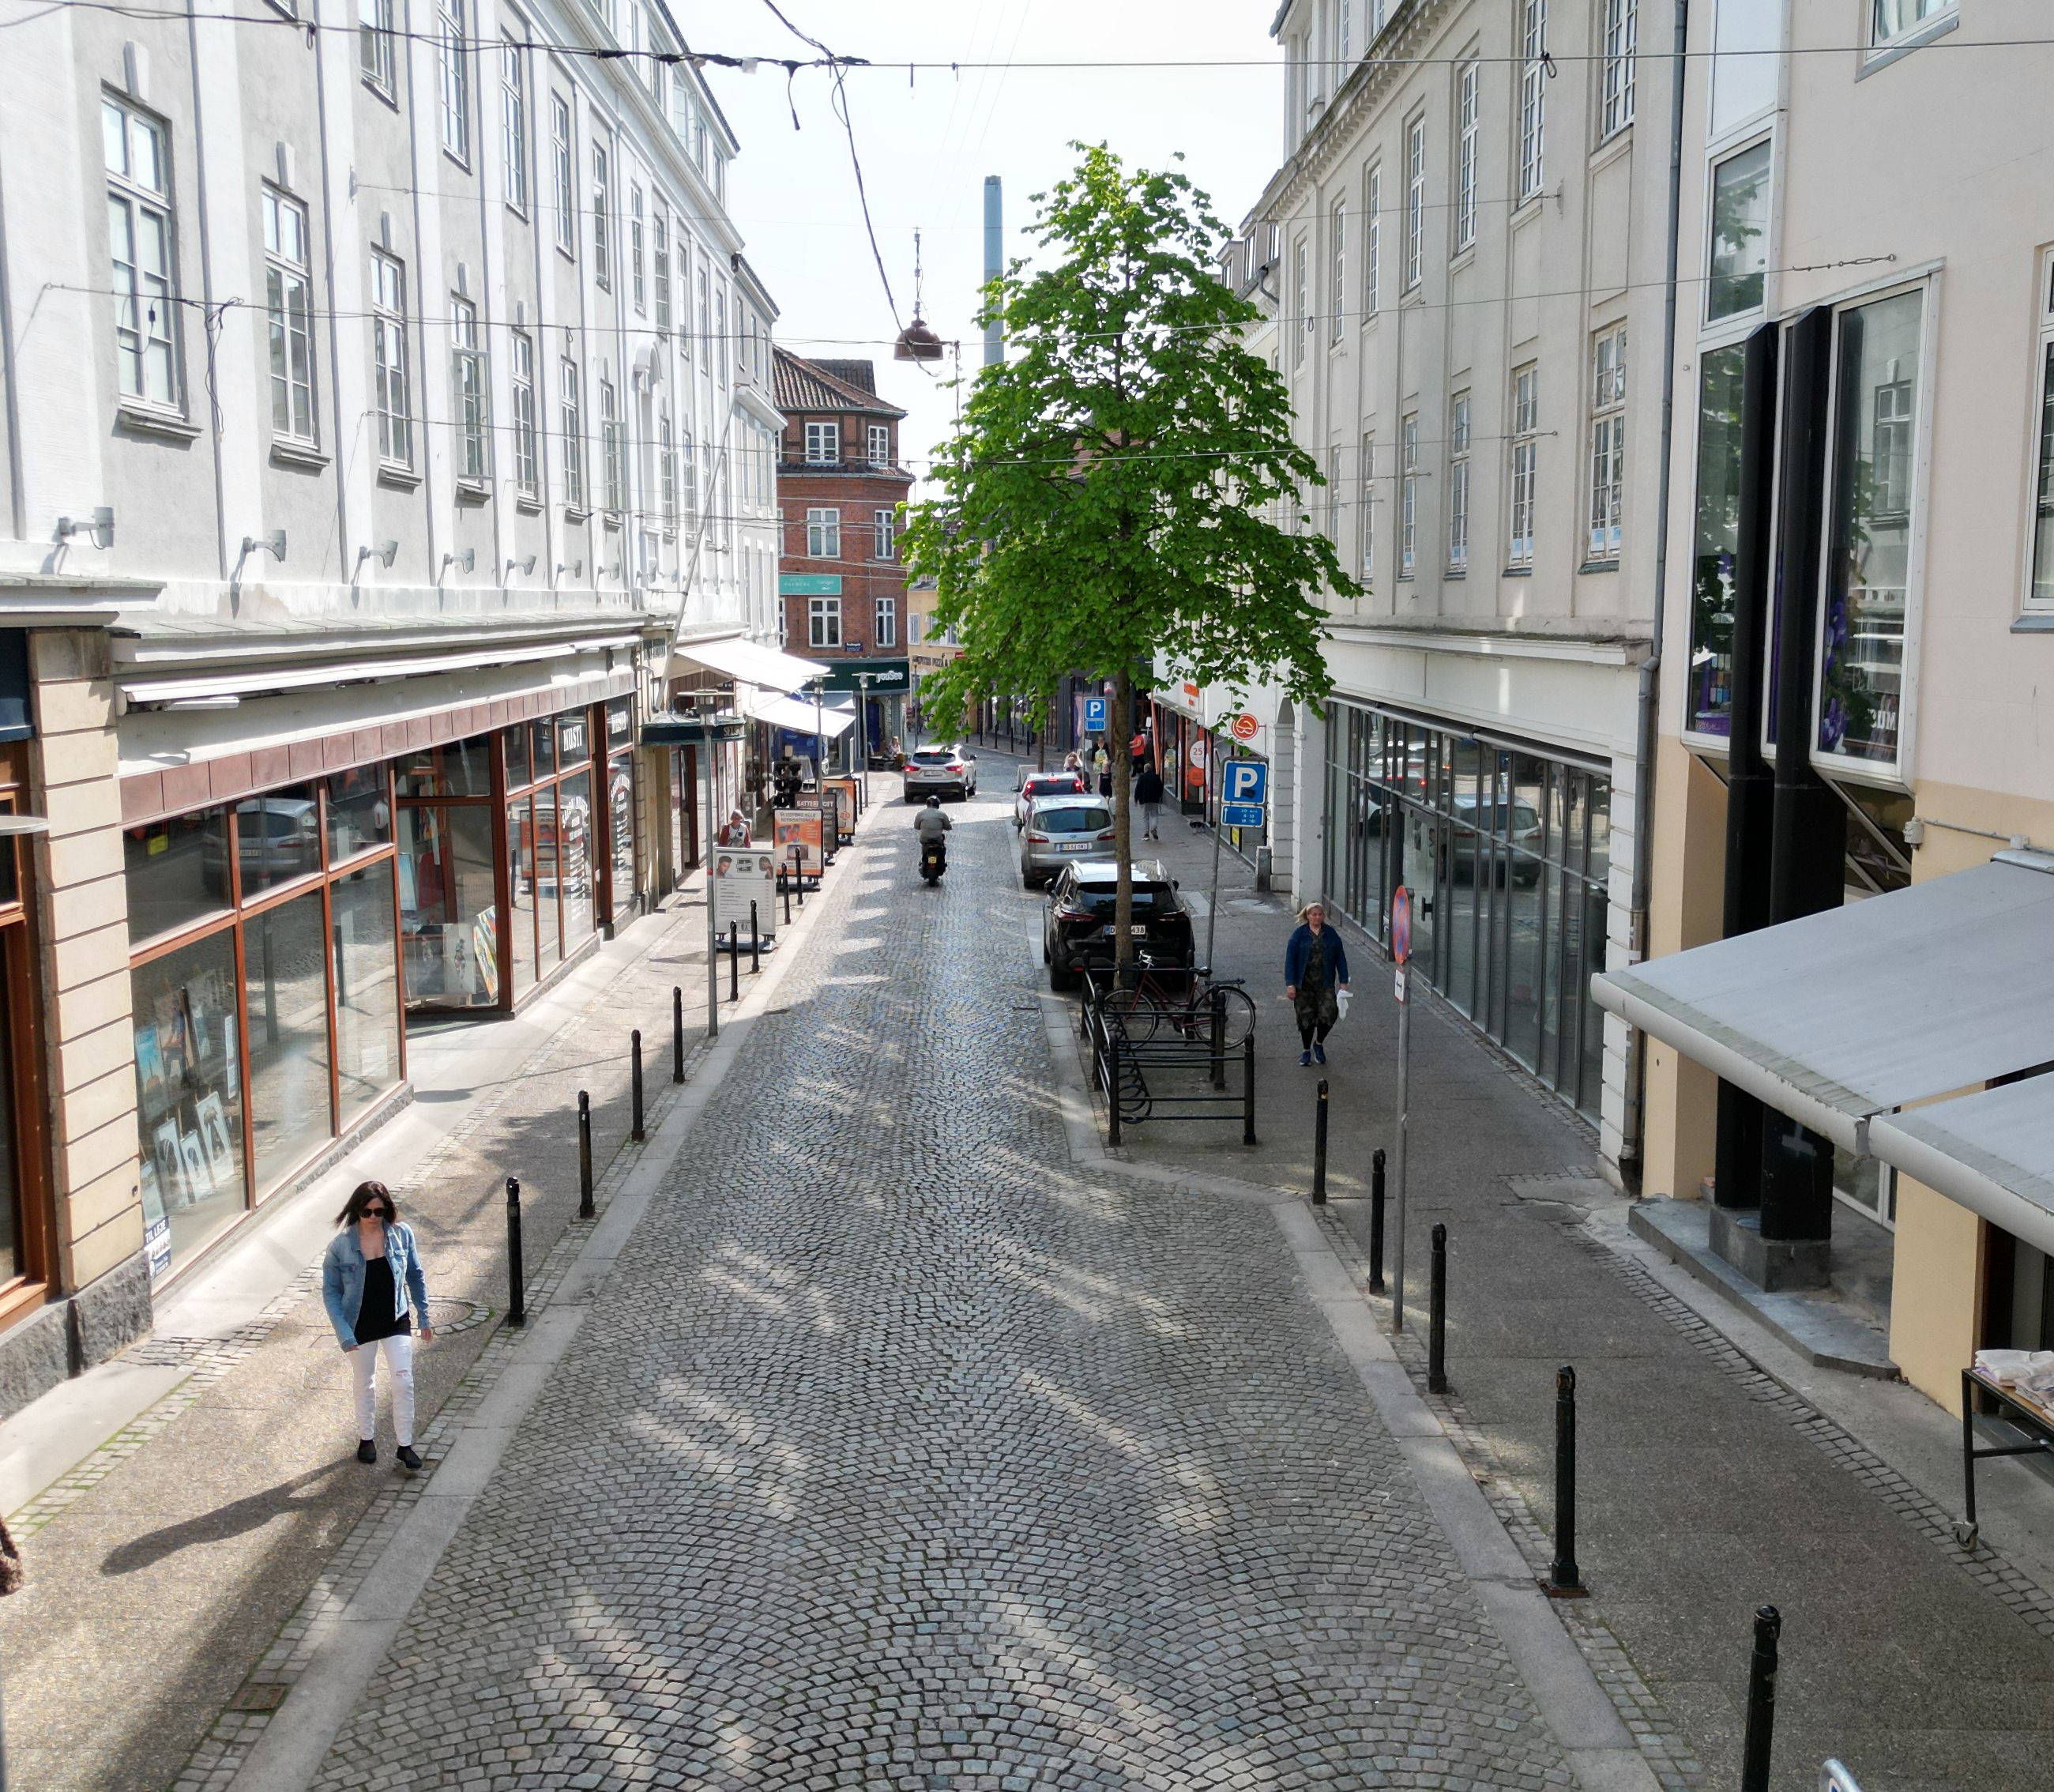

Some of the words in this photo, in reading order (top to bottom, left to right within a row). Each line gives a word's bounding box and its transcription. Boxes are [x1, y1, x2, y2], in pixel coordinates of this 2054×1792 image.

[1090, 702, 1101, 717] P
[563, 725, 582, 751] MUSTI
[1234, 766, 1258, 798] P
[145, 1229, 154, 1244] TIL
